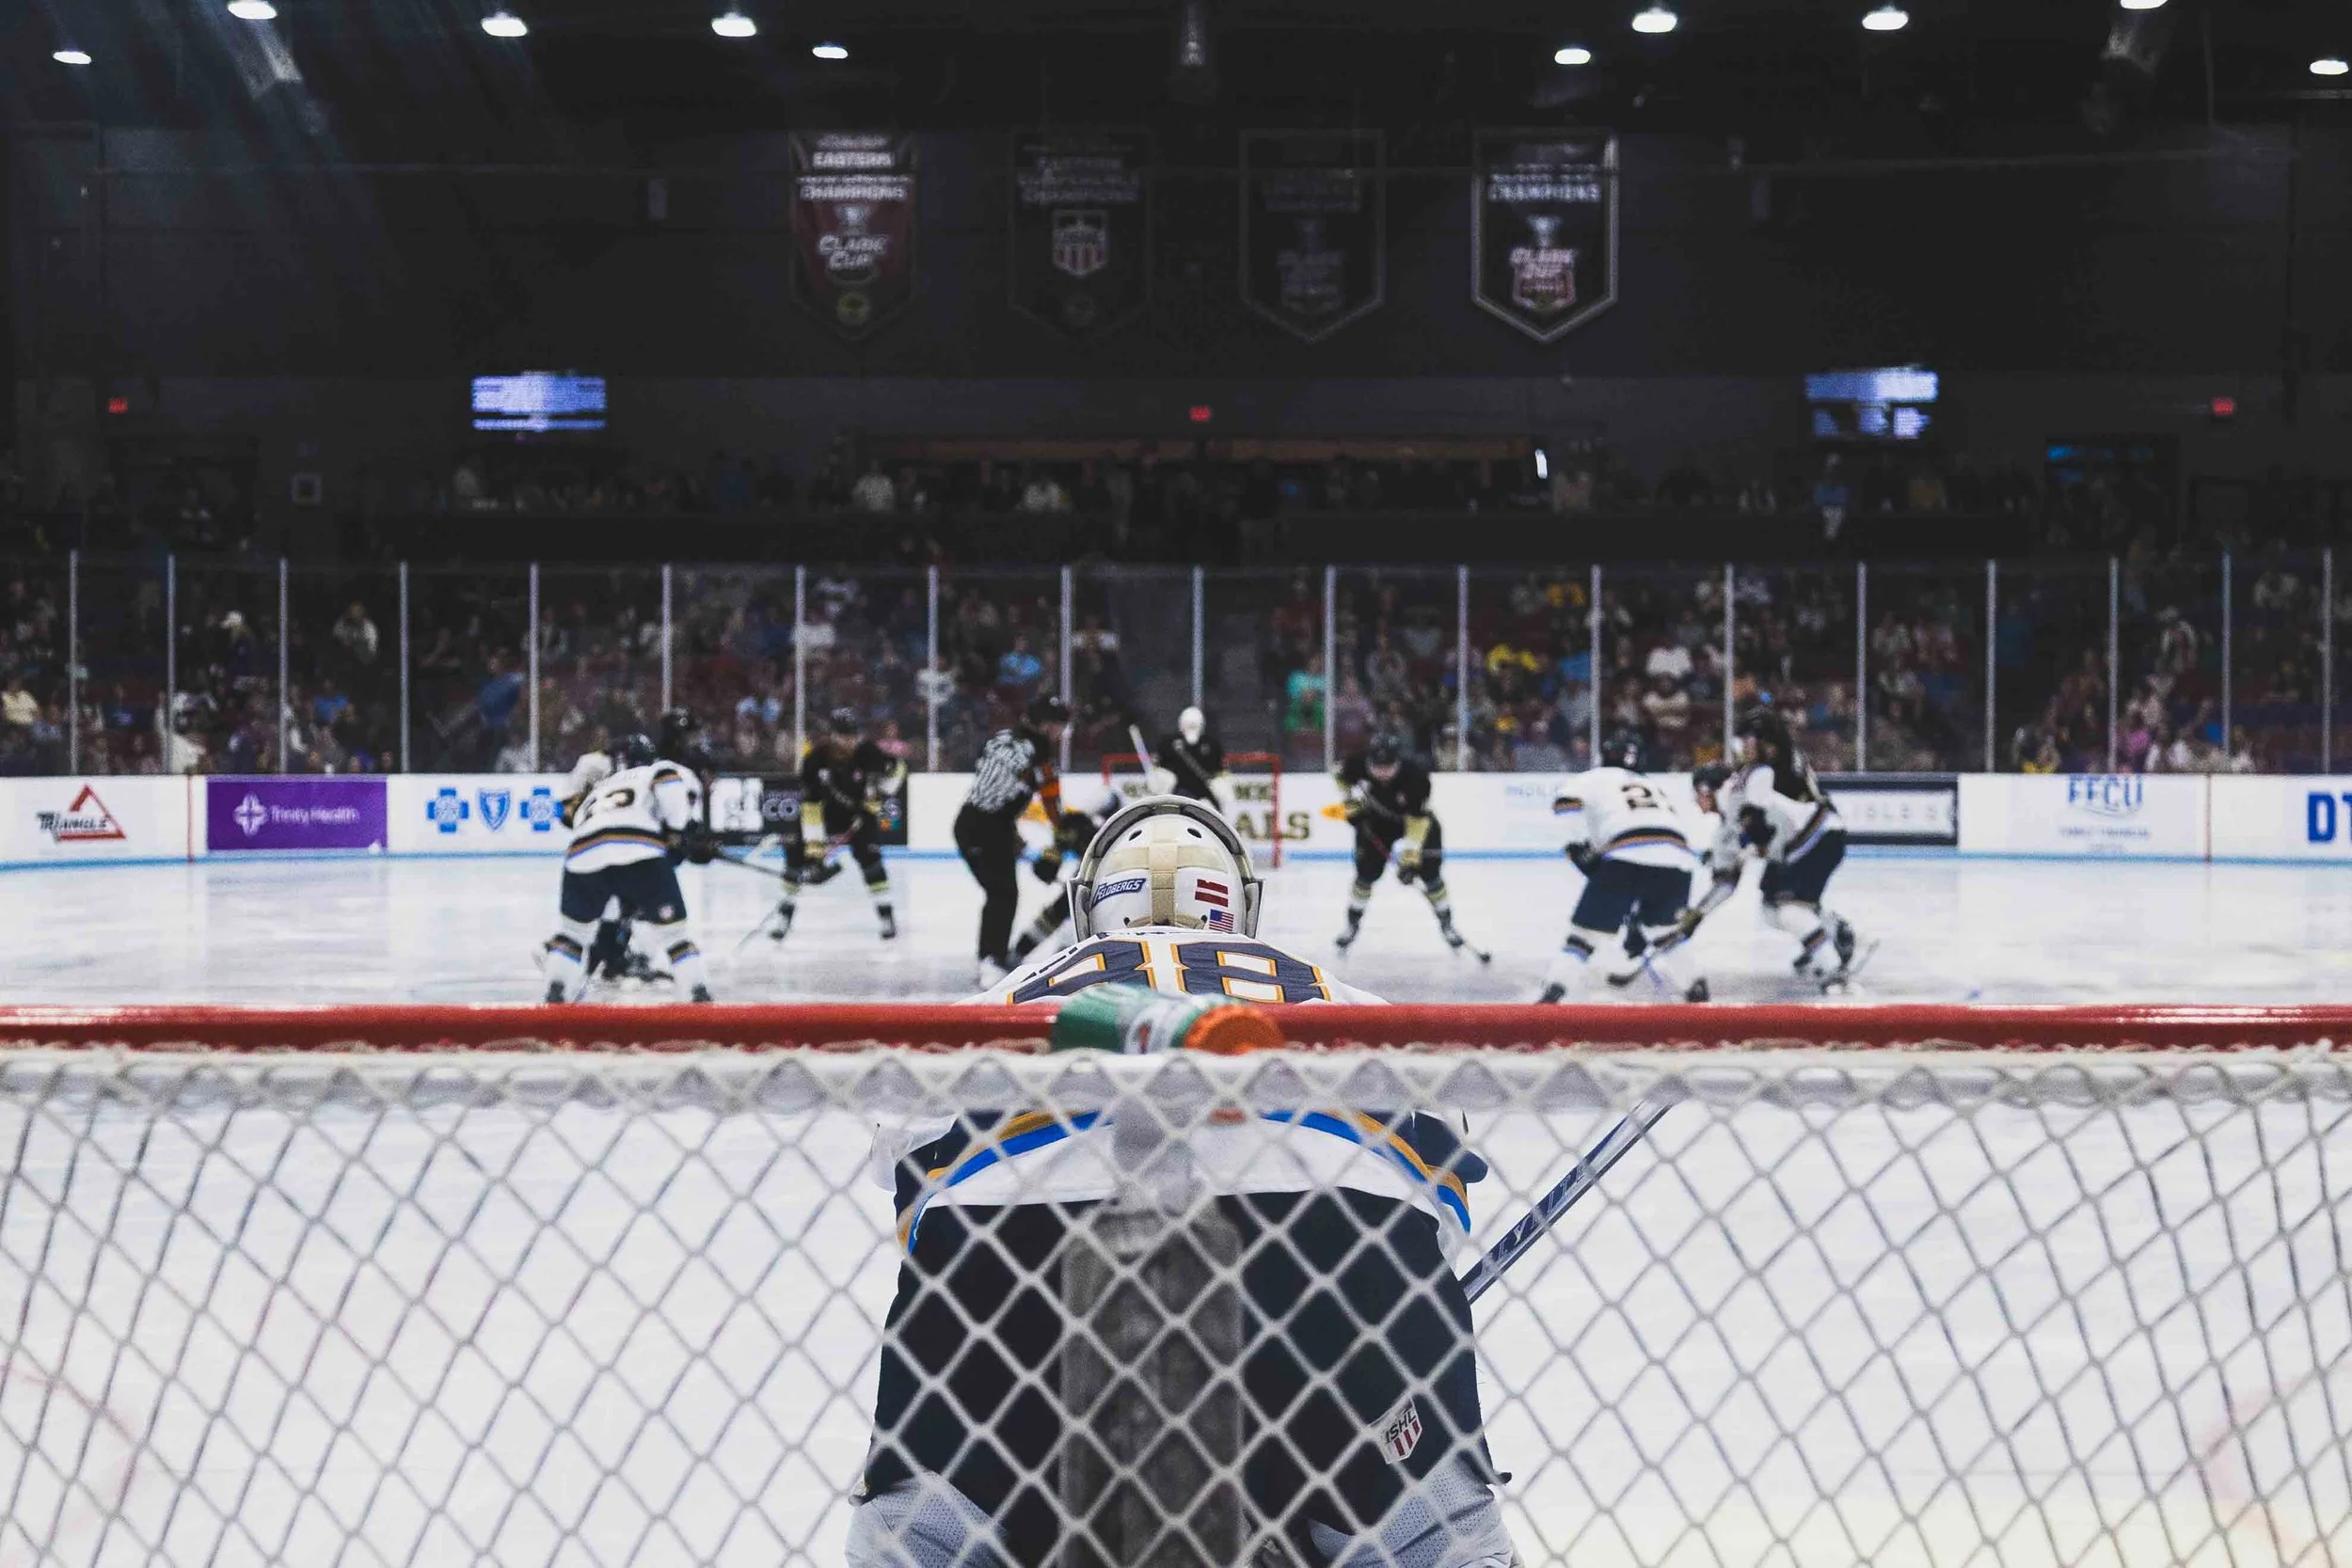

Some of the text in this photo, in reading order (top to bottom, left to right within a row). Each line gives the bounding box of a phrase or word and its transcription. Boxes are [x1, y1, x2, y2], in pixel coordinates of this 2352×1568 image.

[271, 806, 359, 826] Trinity Health
[1092, 879, 1143, 905] FELDBERGS
